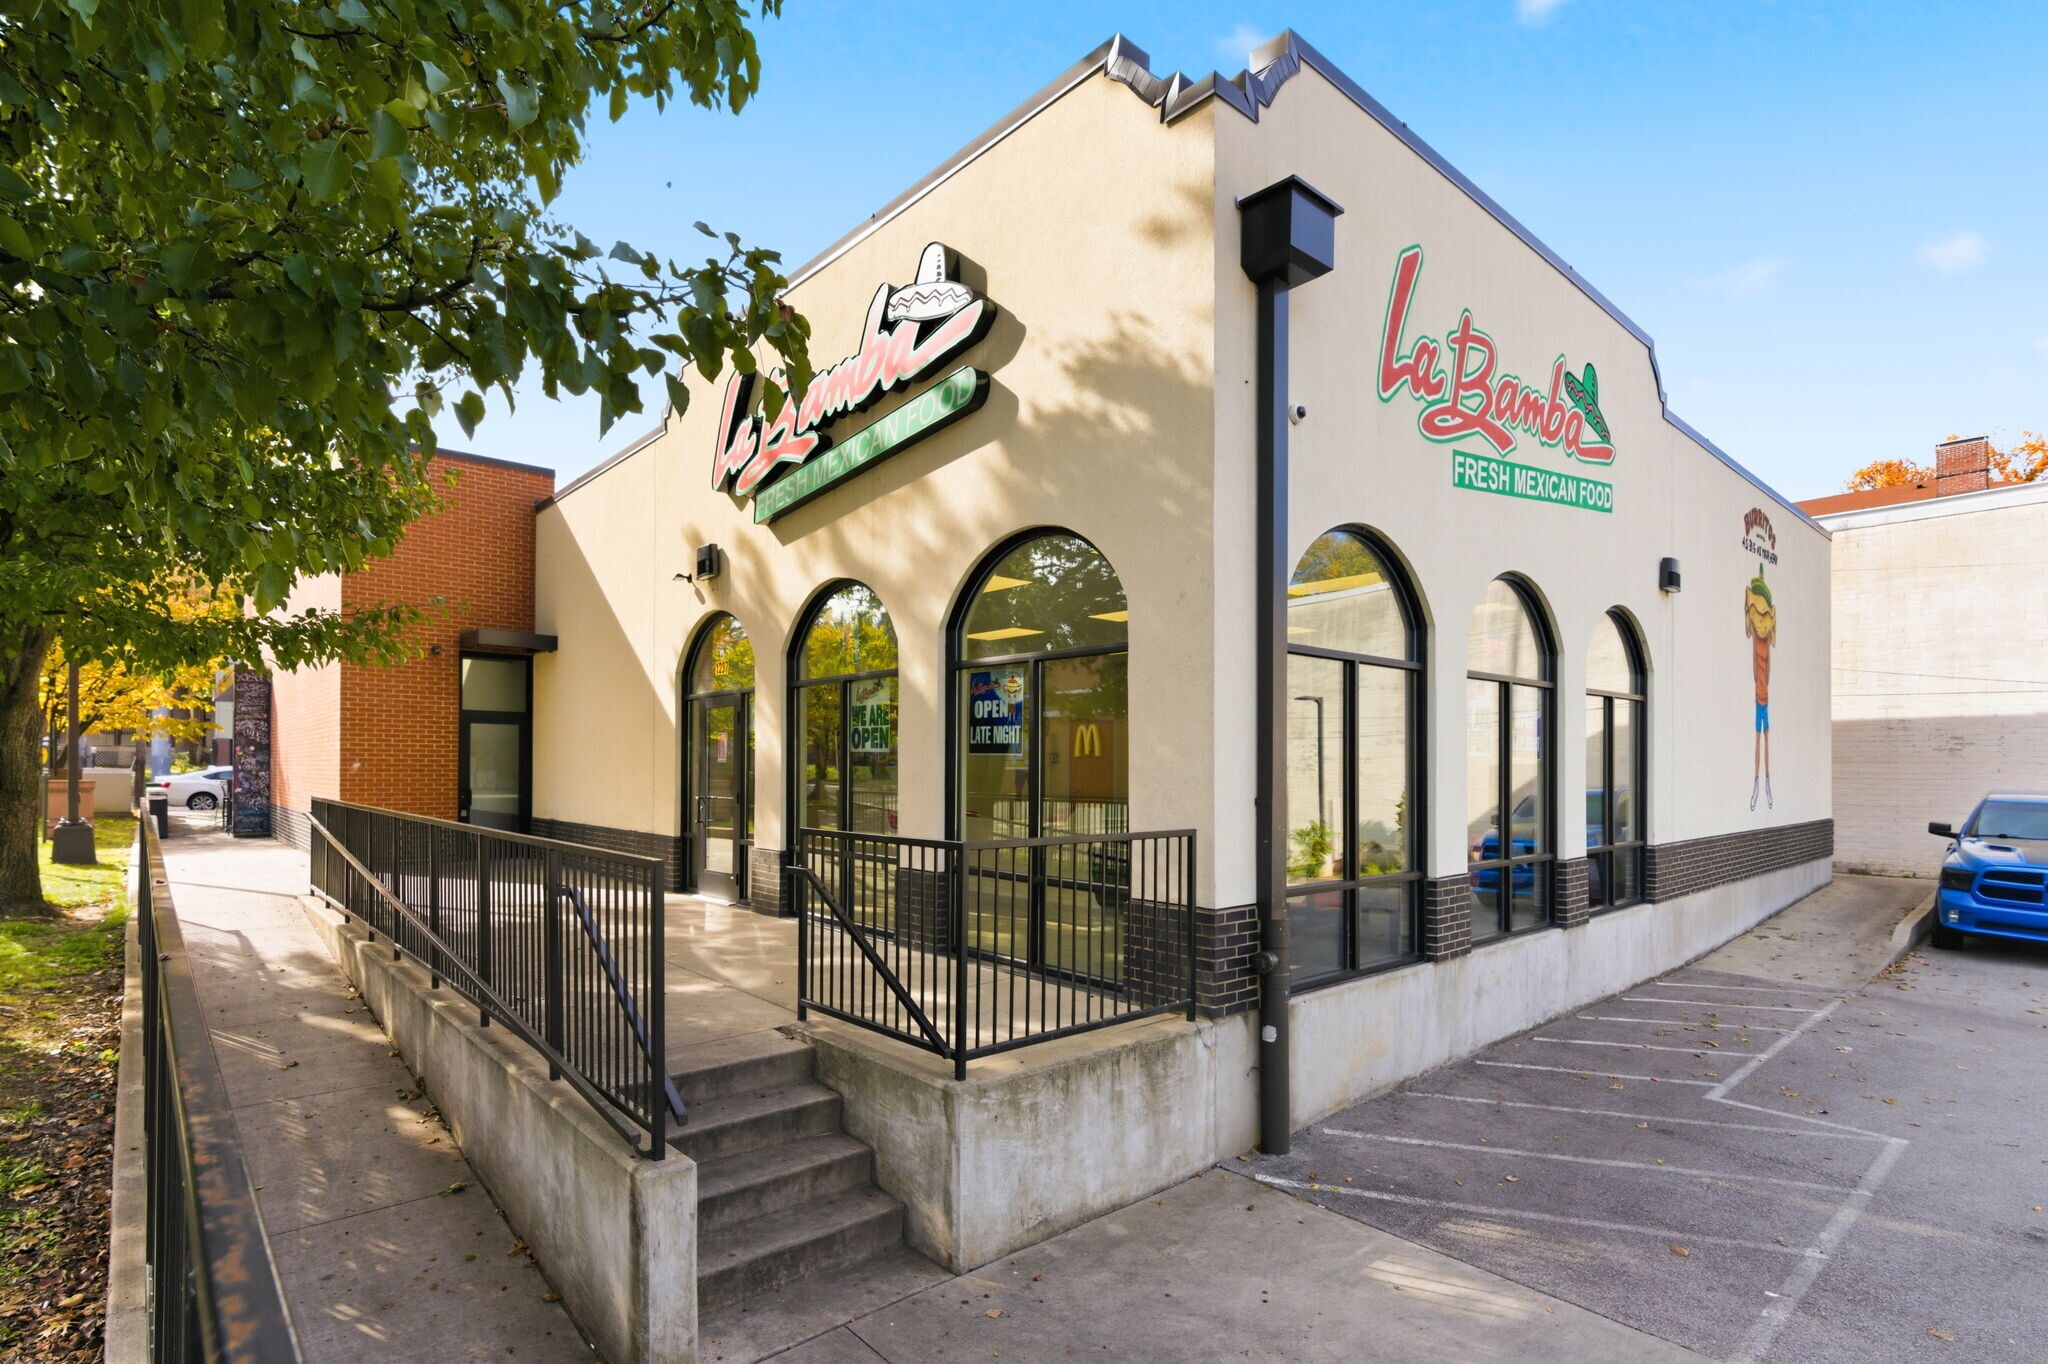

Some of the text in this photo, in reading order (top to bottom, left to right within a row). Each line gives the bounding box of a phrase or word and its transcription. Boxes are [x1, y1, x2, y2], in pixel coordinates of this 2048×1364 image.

[1378, 244, 1616, 465] La Bamba
[712, 281, 983, 496] La Bamba
[756, 372, 974, 514] FRESH MEXICAN FOOD
[1454, 455, 1612, 509] FRESH MEXICAN FOOD
[1744, 507, 1776, 551] BURRITOS
[852, 703, 889, 727] WE ARE
[974, 699, 1009, 719] OPEN
[852, 727, 889, 749] OPEN
[970, 725, 1021, 745] LATE NIGHT
